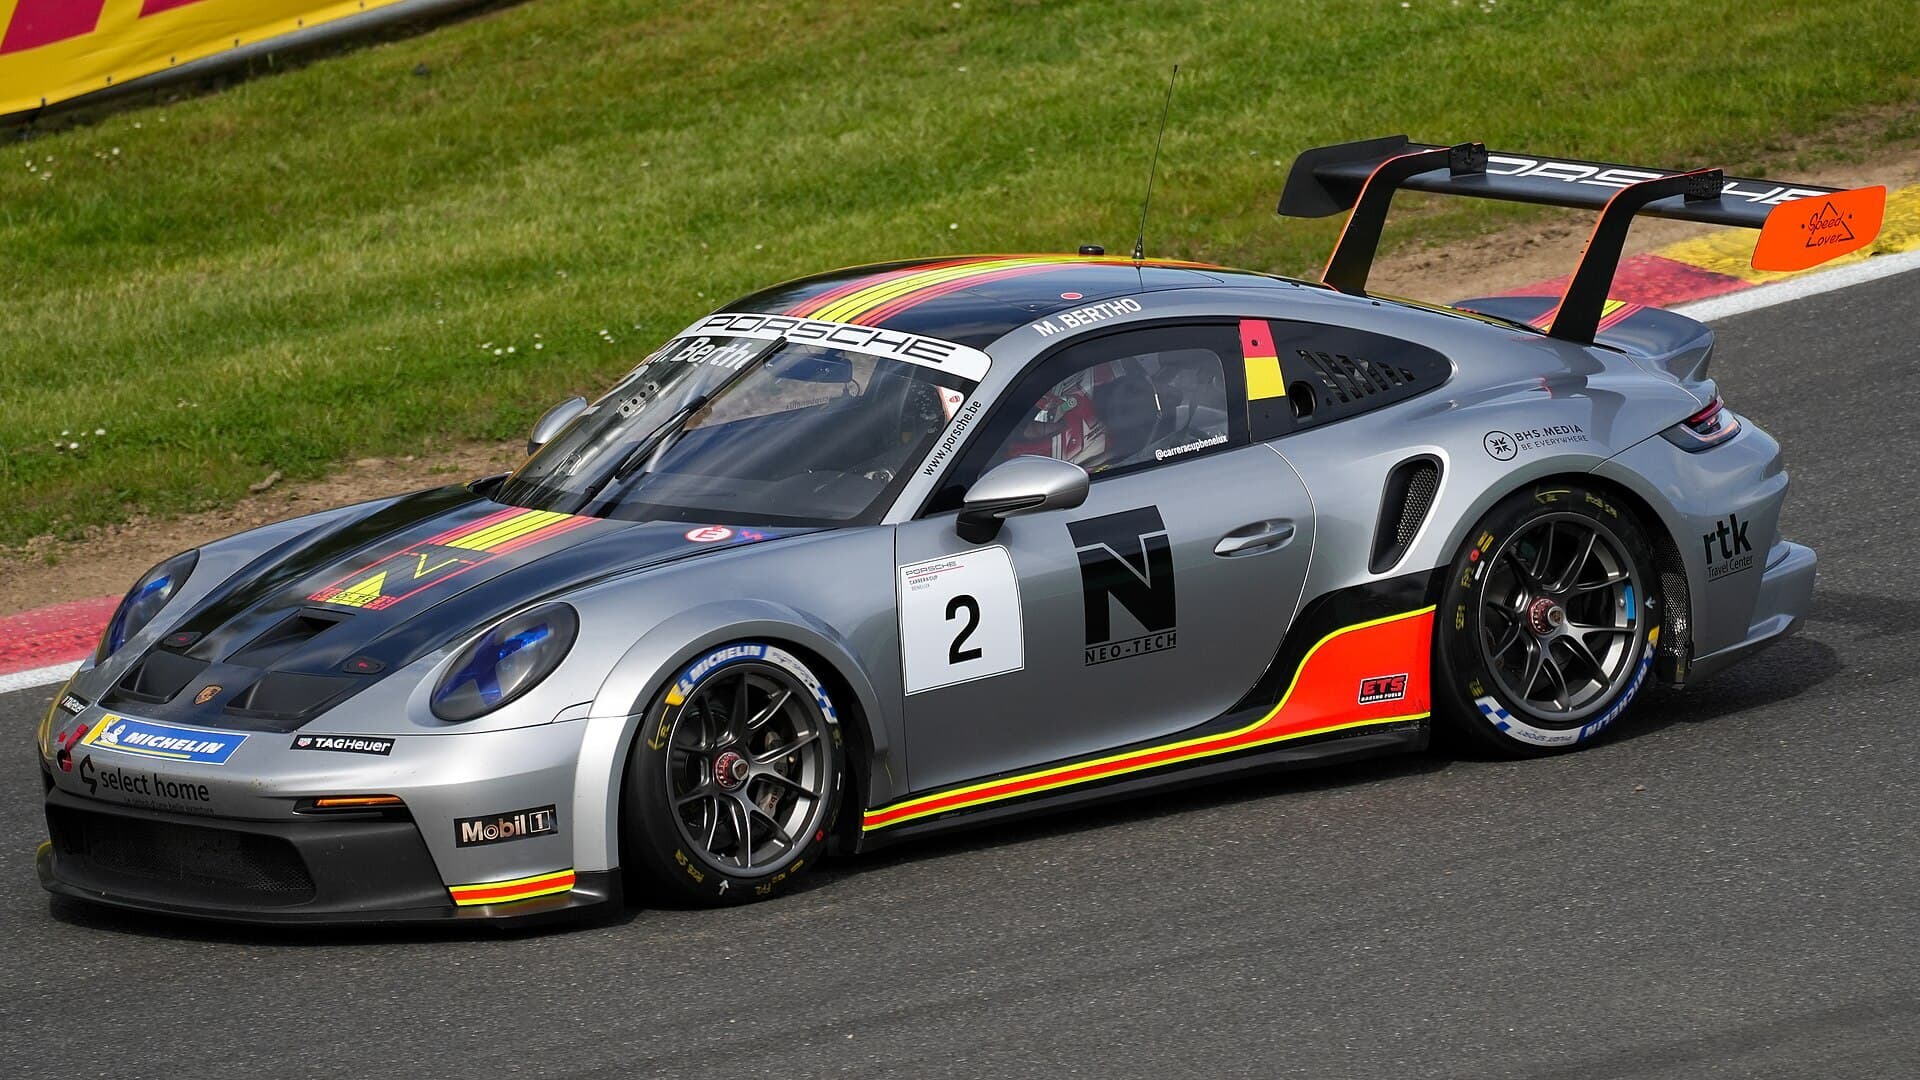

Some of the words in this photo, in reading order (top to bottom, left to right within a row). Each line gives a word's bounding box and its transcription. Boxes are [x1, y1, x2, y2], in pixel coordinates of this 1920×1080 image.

[1807, 210, 1845, 235] Speed
[1806, 233, 1842, 248] Lover
[1032, 320, 1065, 337] M.
[1058, 298, 1142, 329] BERTHO
[669, 336, 758, 371] Berth
[695, 314, 957, 364] PORSCHE
[923, 401, 982, 476] www.porsche.be
[1155, 434, 1229, 461] @carreracupbenelux
[1514, 425, 1584, 442] BHS.MEDIA
[1520, 442, 1534, 451] BE
[1534, 435, 1589, 449] EVERYWHERE
[1703, 512, 1753, 566] rtk
[905, 561, 957, 576] PORSCHE
[1066, 504, 1177, 645] N
[1706, 560, 1729, 578] Travel
[1729, 555, 1753, 571] Center
[945, 594, 983, 665] 2
[690, 645, 762, 682] MICHELIN
[1085, 632, 1177, 665] NEO-TECH
[1362, 676, 1405, 696] ETS
[1585, 662, 1648, 739] MICHELIN
[122, 732, 226, 755] MICHELIN
[101, 768, 152, 795] select
[153, 773, 210, 802] home
[462, 814, 527, 842] Mobil
